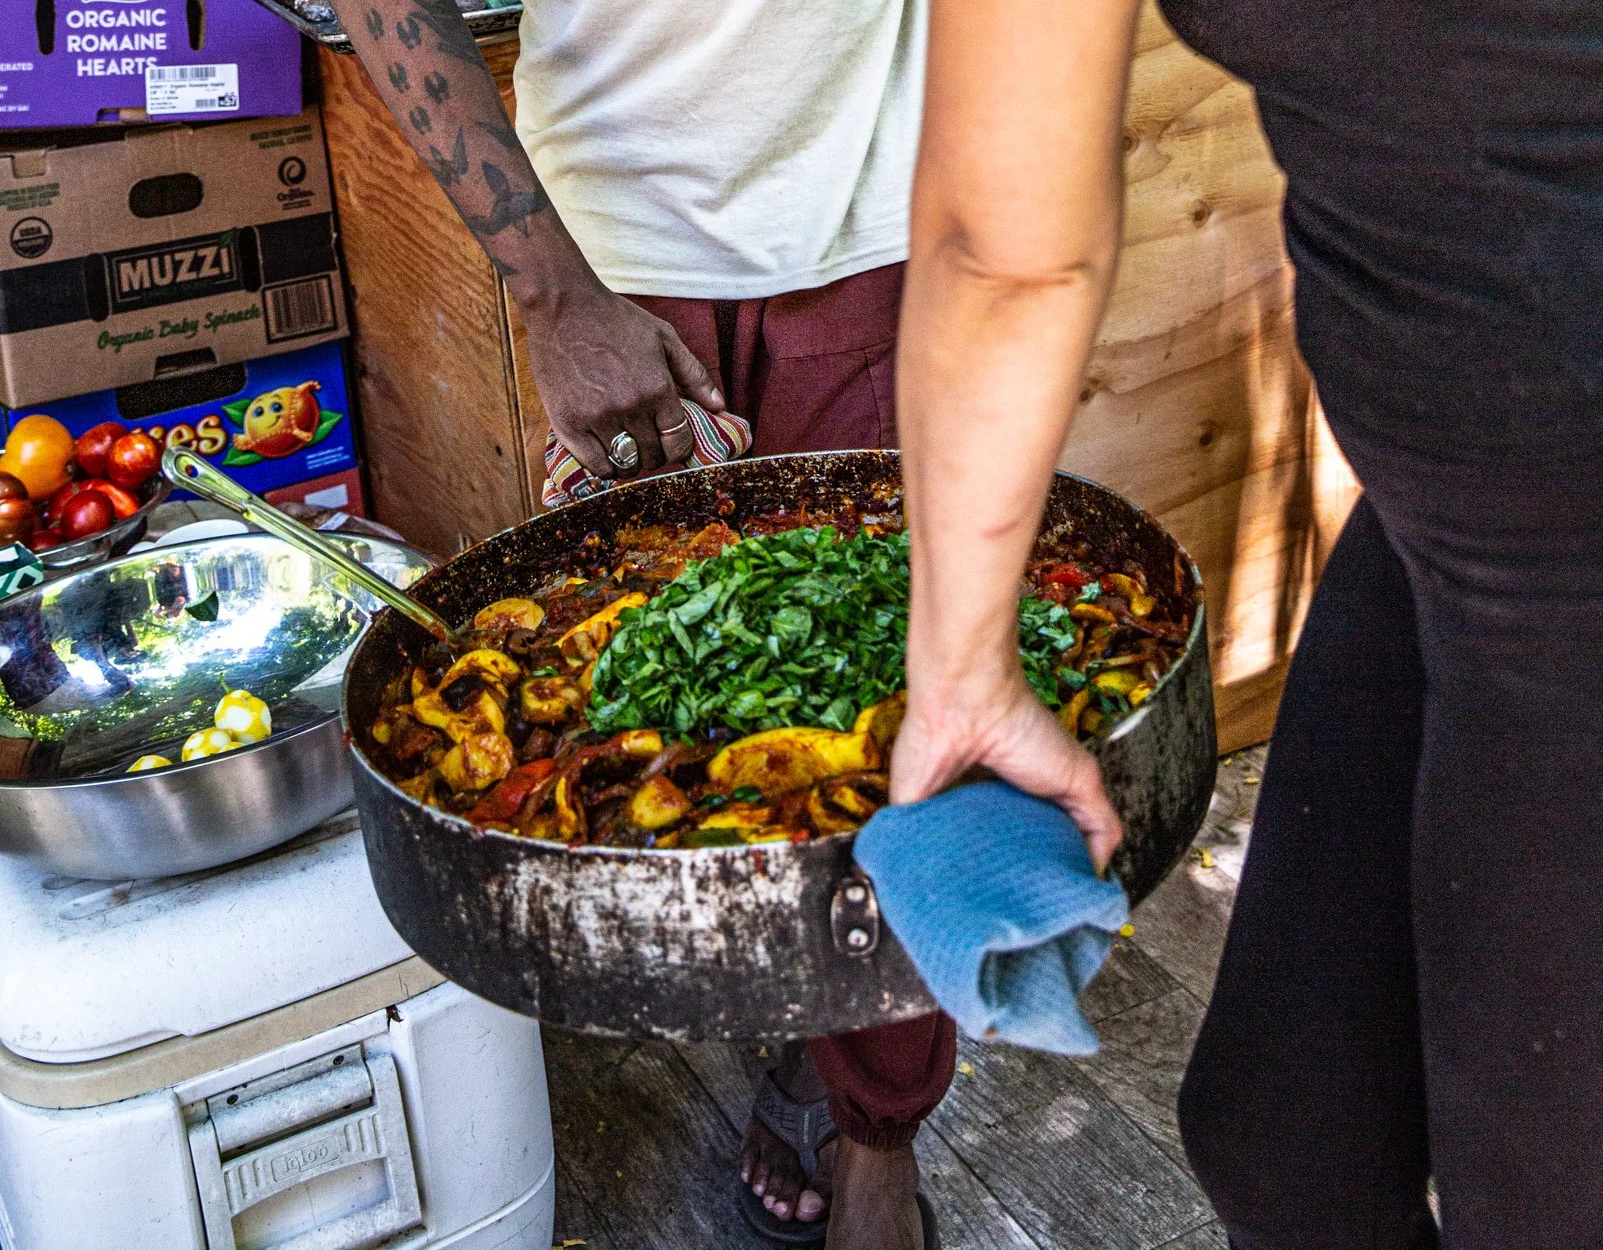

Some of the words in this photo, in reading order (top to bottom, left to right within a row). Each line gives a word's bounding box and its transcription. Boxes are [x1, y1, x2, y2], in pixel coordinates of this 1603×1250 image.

[66, 9, 166, 28] ORGANIC
[67, 33, 167, 52] ROMAINE
[119, 246, 231, 293] MUZZI
[97, 327, 153, 353] Organic
[159, 317, 198, 339] Baby
[204, 303, 260, 334] Spinach
